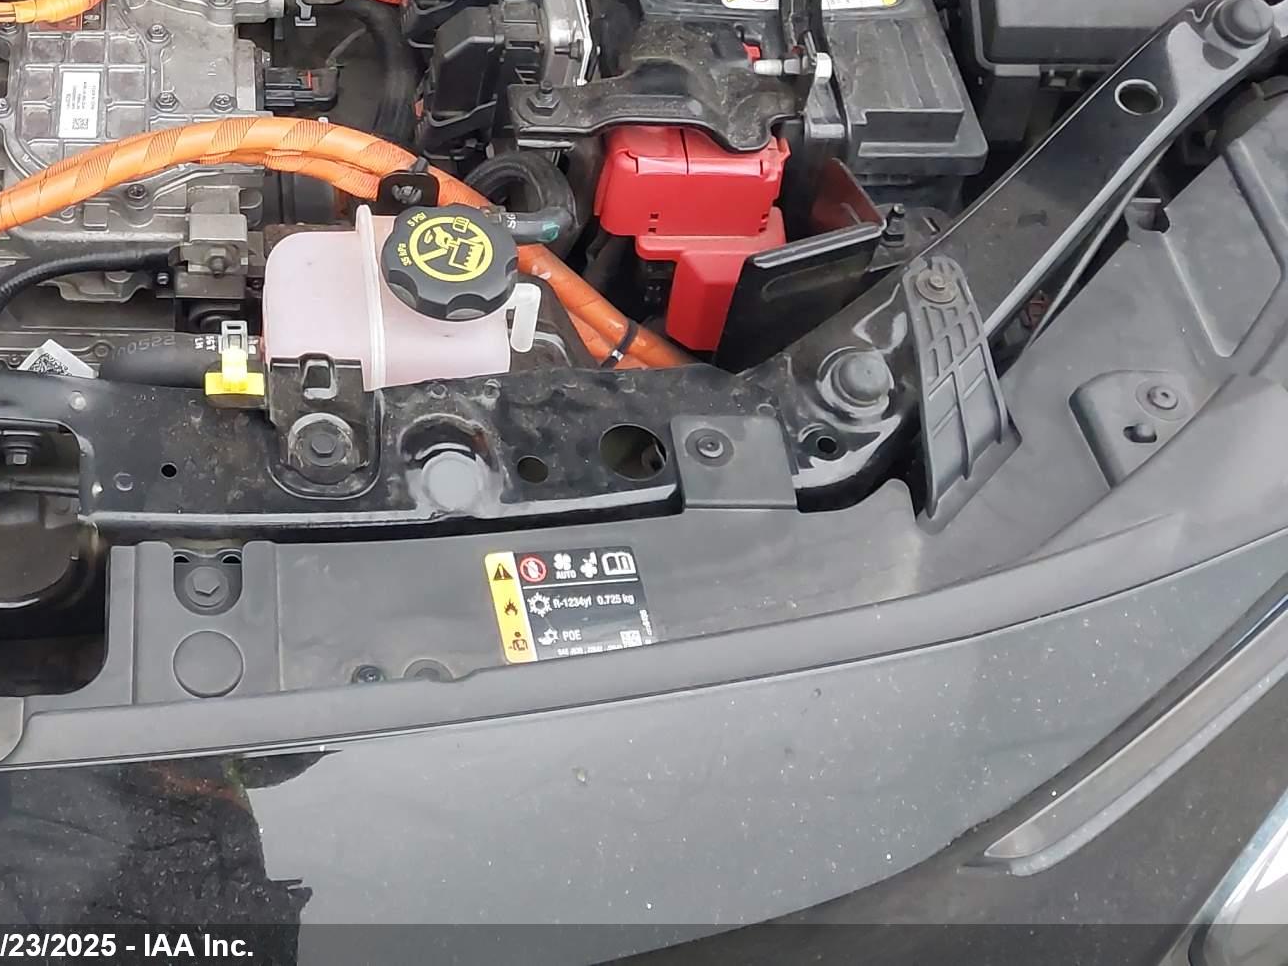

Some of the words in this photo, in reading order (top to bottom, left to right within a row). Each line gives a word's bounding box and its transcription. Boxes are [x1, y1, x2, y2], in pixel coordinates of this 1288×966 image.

[414, 212, 426, 225] PSI
[556, 570, 576, 579] AUTO
[596, 594, 622, 606] 0.725
[622, 594, 634, 605] kg
[562, 630, 582, 641] POE
